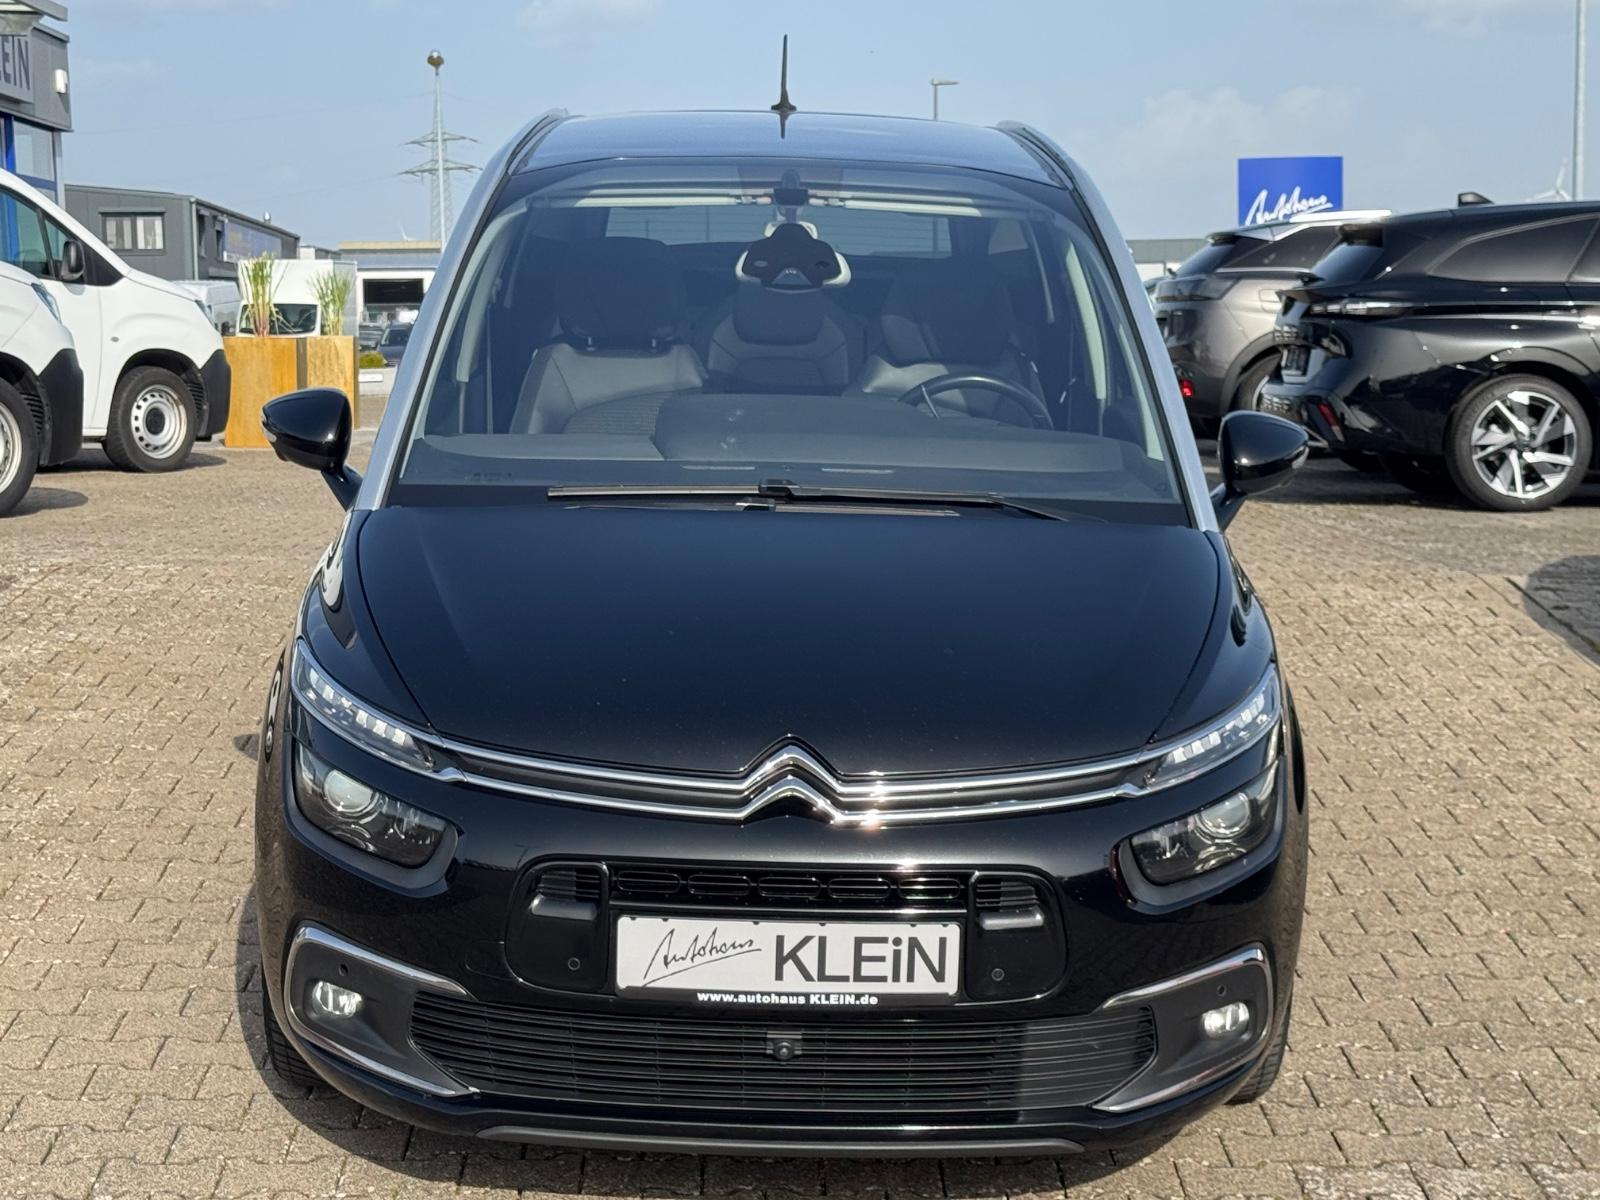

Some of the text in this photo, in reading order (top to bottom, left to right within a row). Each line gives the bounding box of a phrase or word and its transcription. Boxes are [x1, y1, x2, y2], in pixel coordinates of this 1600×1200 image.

[0, 35, 31, 91] EIN
[643, 927, 762, 987] Autohaus
[696, 992, 879, 1005] www.autohaus KLEIN.de
